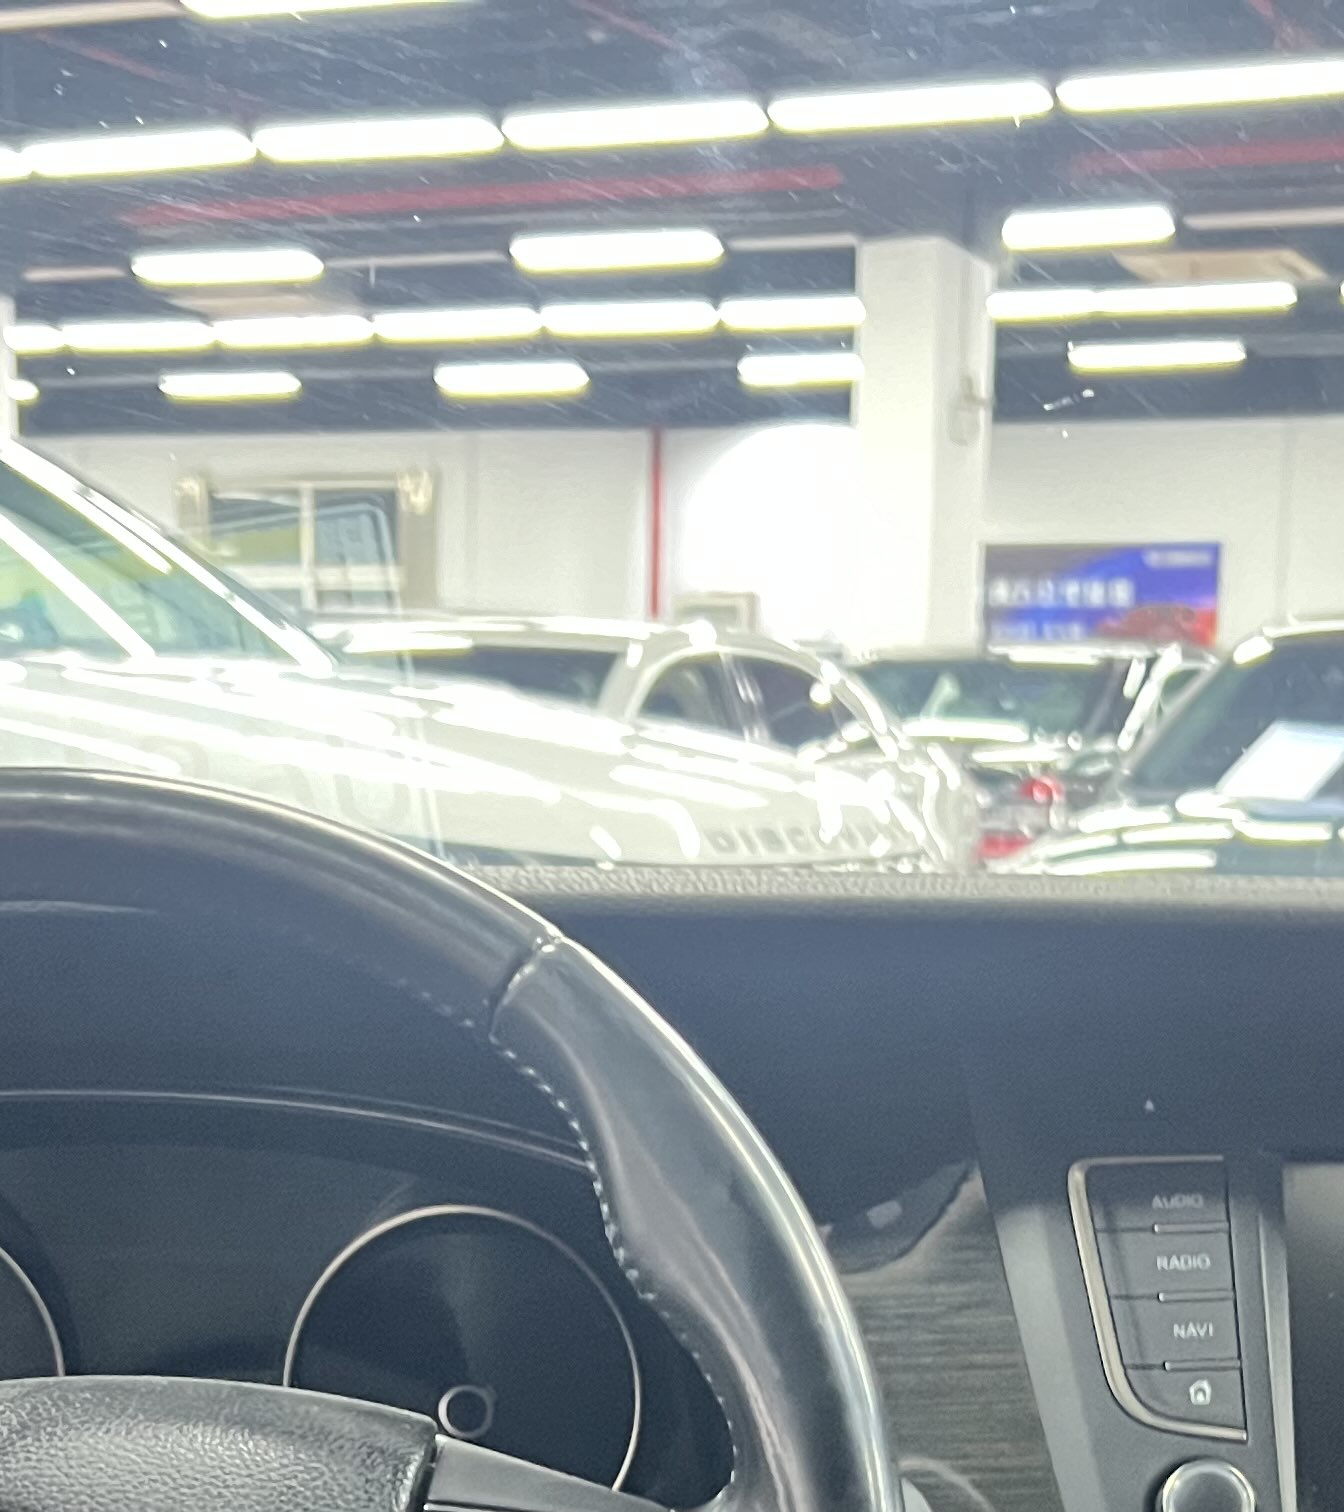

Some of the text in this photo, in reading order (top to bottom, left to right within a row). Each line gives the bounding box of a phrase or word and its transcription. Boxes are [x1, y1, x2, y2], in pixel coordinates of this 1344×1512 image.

[1152, 1194, 1204, 1210] AUDIO
[1156, 1254, 1211, 1271] RADIO
[1173, 1322, 1214, 1338] NAVI
